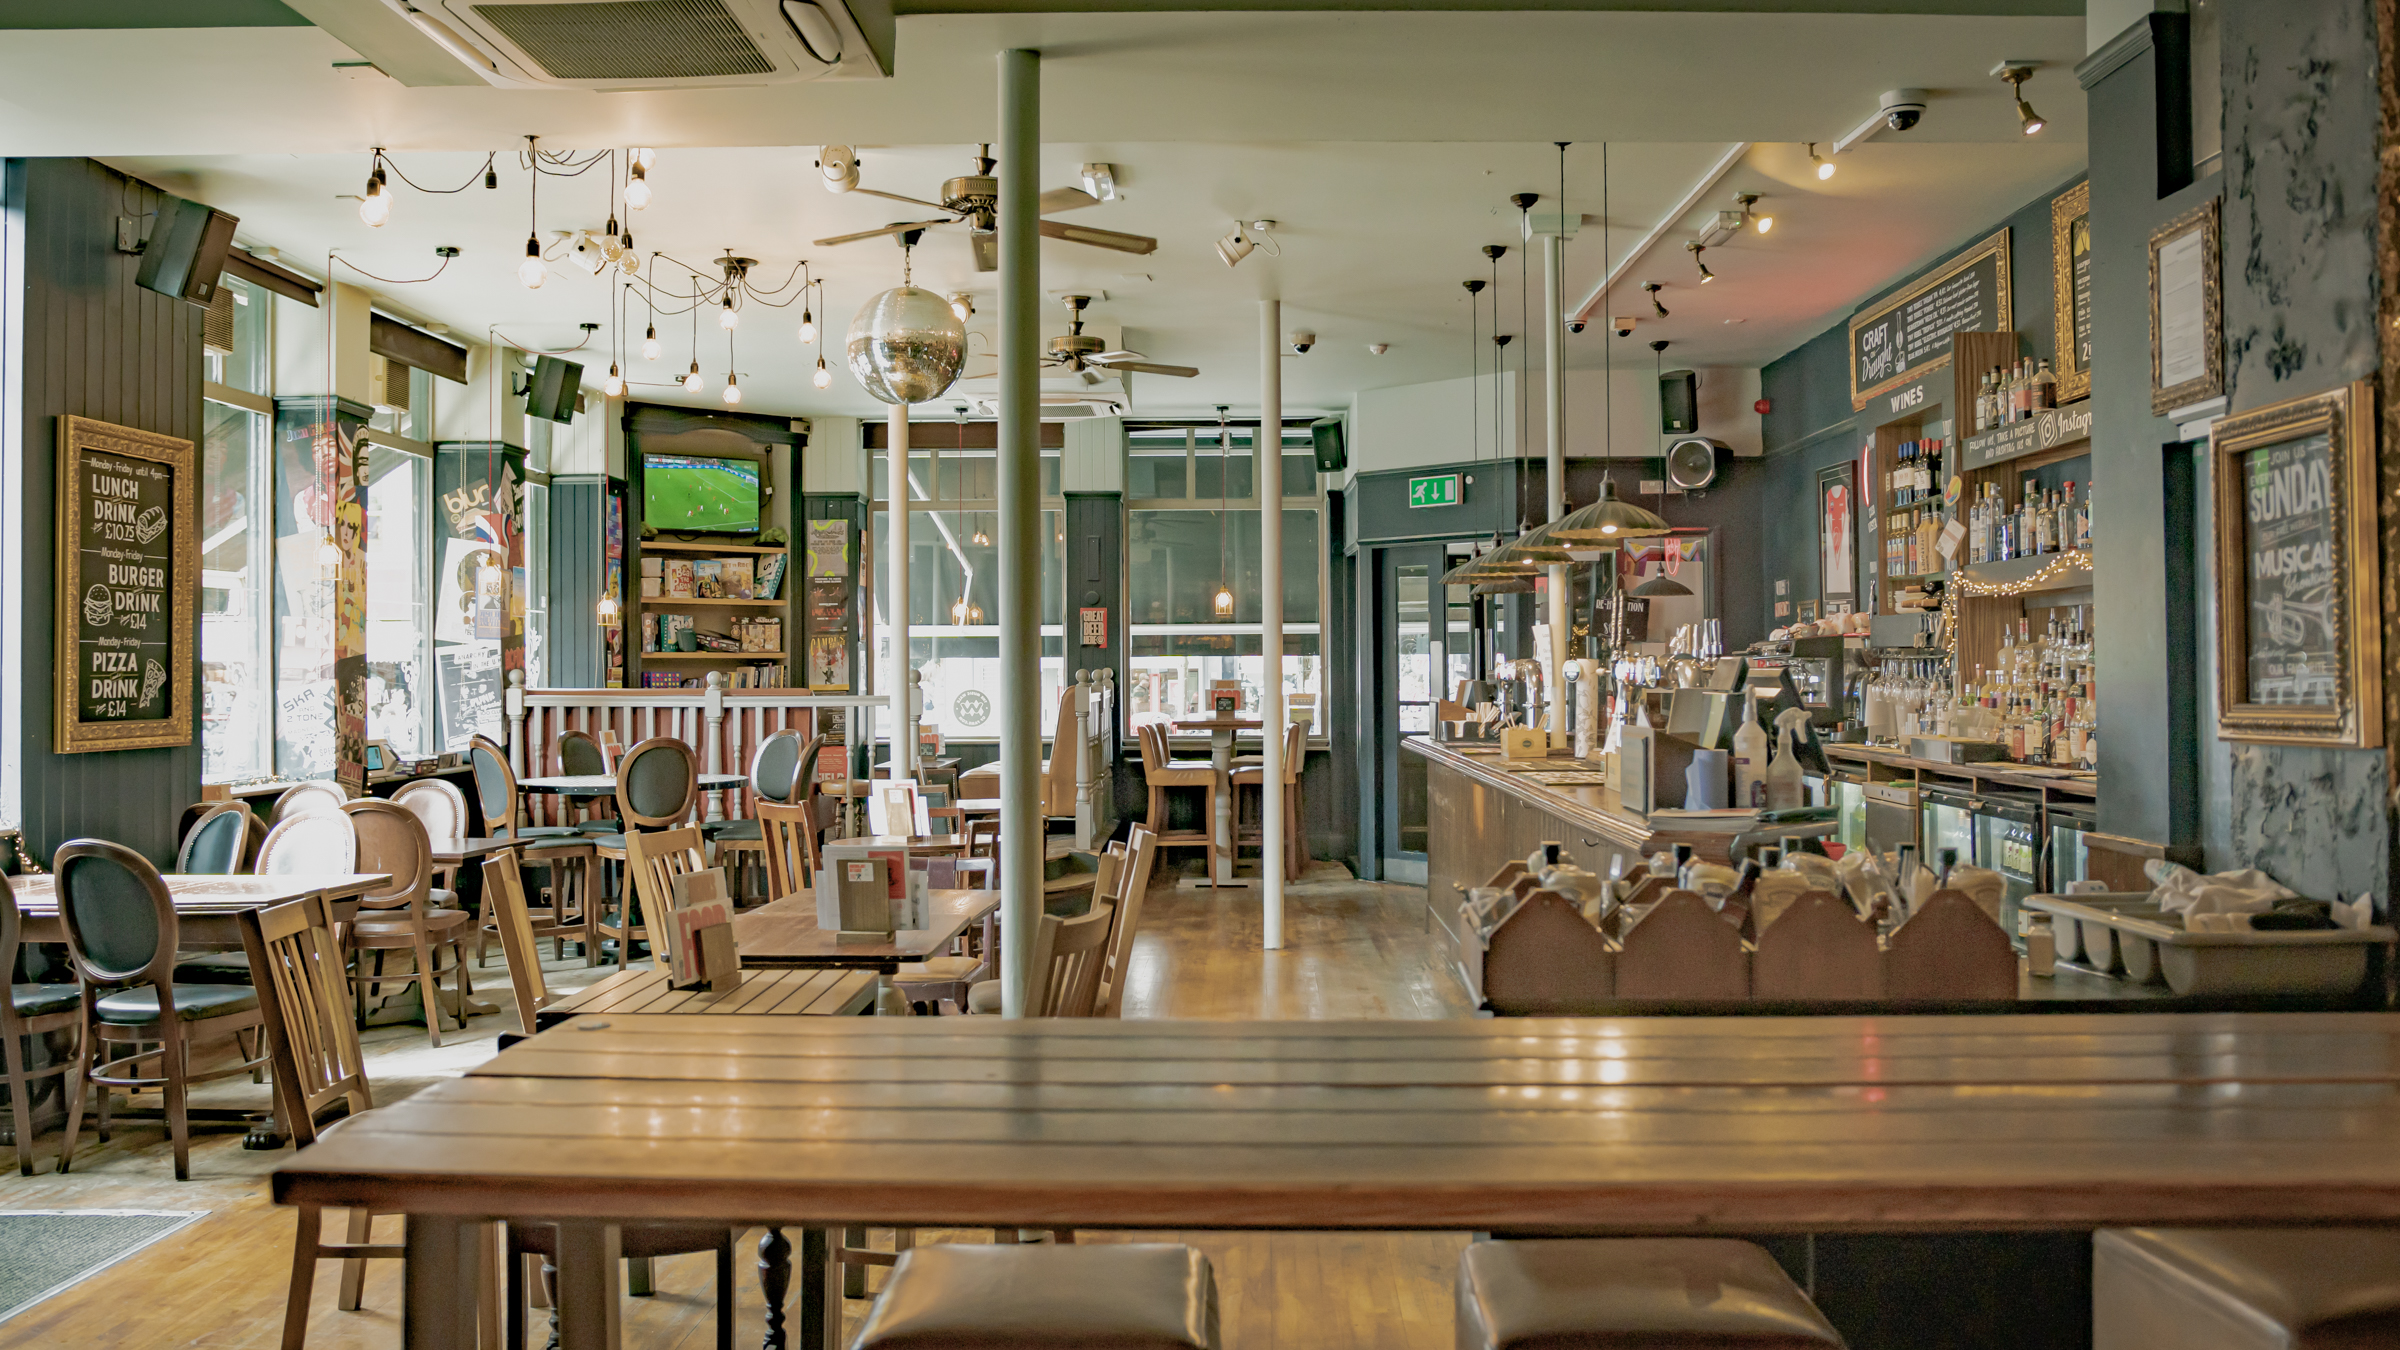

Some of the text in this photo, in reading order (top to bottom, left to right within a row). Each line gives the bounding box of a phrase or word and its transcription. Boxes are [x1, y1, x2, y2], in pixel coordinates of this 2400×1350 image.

[1863, 322, 1889, 352] CRAFT
[1862, 342, 1893, 382] Draught
[1890, 385, 1924, 413] WINES
[286, 428, 309, 442] JIMI
[1969, 437, 1987, 453] FOLLOW
[1996, 430, 2009, 443] TAKE
[2009, 429, 2014, 440] A
[2014, 422, 2036, 438] PICTURE
[1985, 448, 1995, 460] AND
[1995, 443, 2015, 456] HASHTAG
[2271, 444, 2306, 466] JOIN US
[135, 467, 148, 477] until
[150, 468, 163, 480] 4pm
[2250, 471, 2275, 487] EVERY
[92, 473, 139, 500] LUNCH
[2250, 458, 2332, 523] SUNDAY
[443, 484, 489, 513] blur
[94, 500, 137, 524] DRINK
[2254, 540, 2333, 579] MUSICAL
[109, 564, 164, 588] BURGER
[115, 591, 160, 613] DRINK
[130, 613, 147, 629] £14
[1083, 611, 1104, 621] GREAT
[1084, 622, 1104, 636] BEER
[92, 652, 138, 672] PIZZA
[457, 651, 486, 660] ANARCHY
[91, 679, 138, 699] DRINK
[108, 700, 127, 717] £14
[283, 688, 315, 713] SKA
[297, 713, 324, 722] TONE
[339, 760, 364, 780] FLOYD
